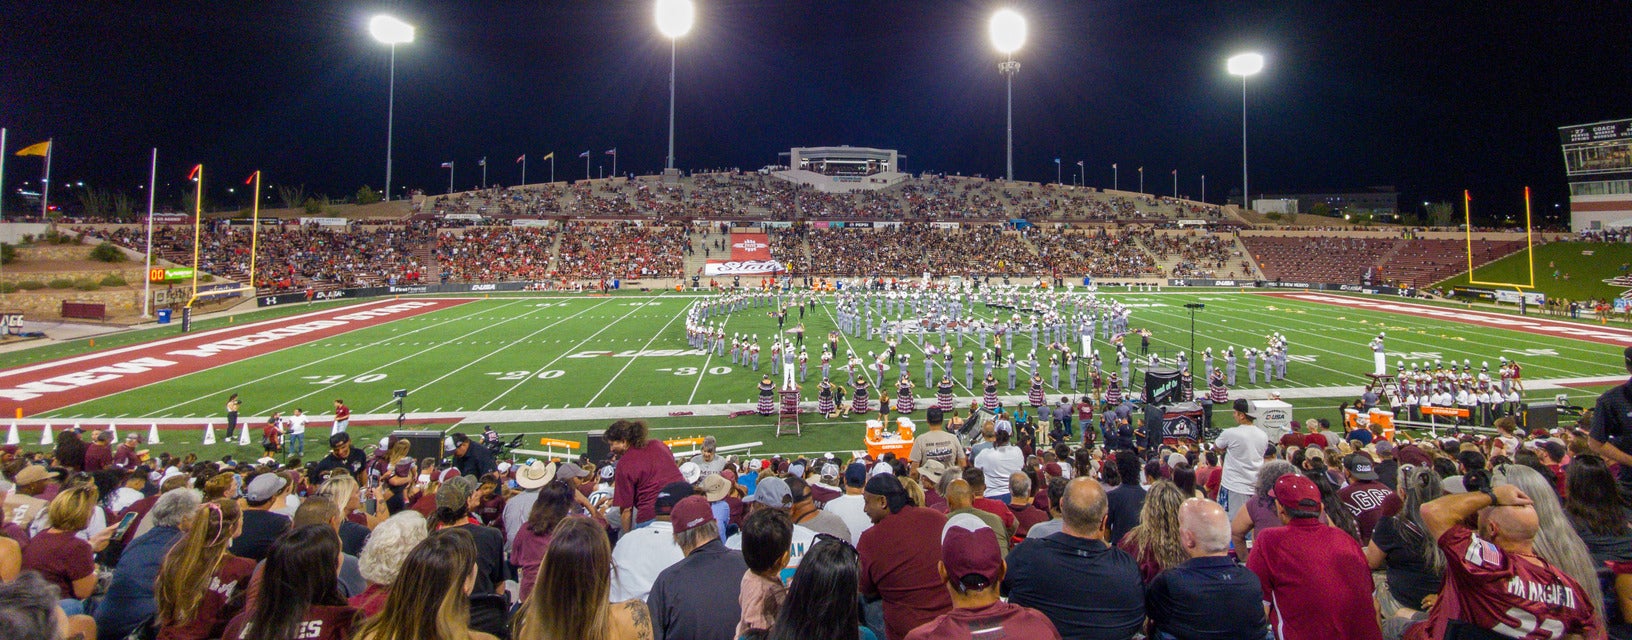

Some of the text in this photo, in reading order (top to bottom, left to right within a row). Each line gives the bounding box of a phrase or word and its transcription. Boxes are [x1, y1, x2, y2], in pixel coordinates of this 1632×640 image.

[0, 357, 178, 401] NEW
[166, 319, 350, 358] MEXICO
[331, 301, 439, 321] STATE
[496, 370, 566, 380] 20
[673, 366, 733, 376] 30
[309, 374, 388, 384] 10
